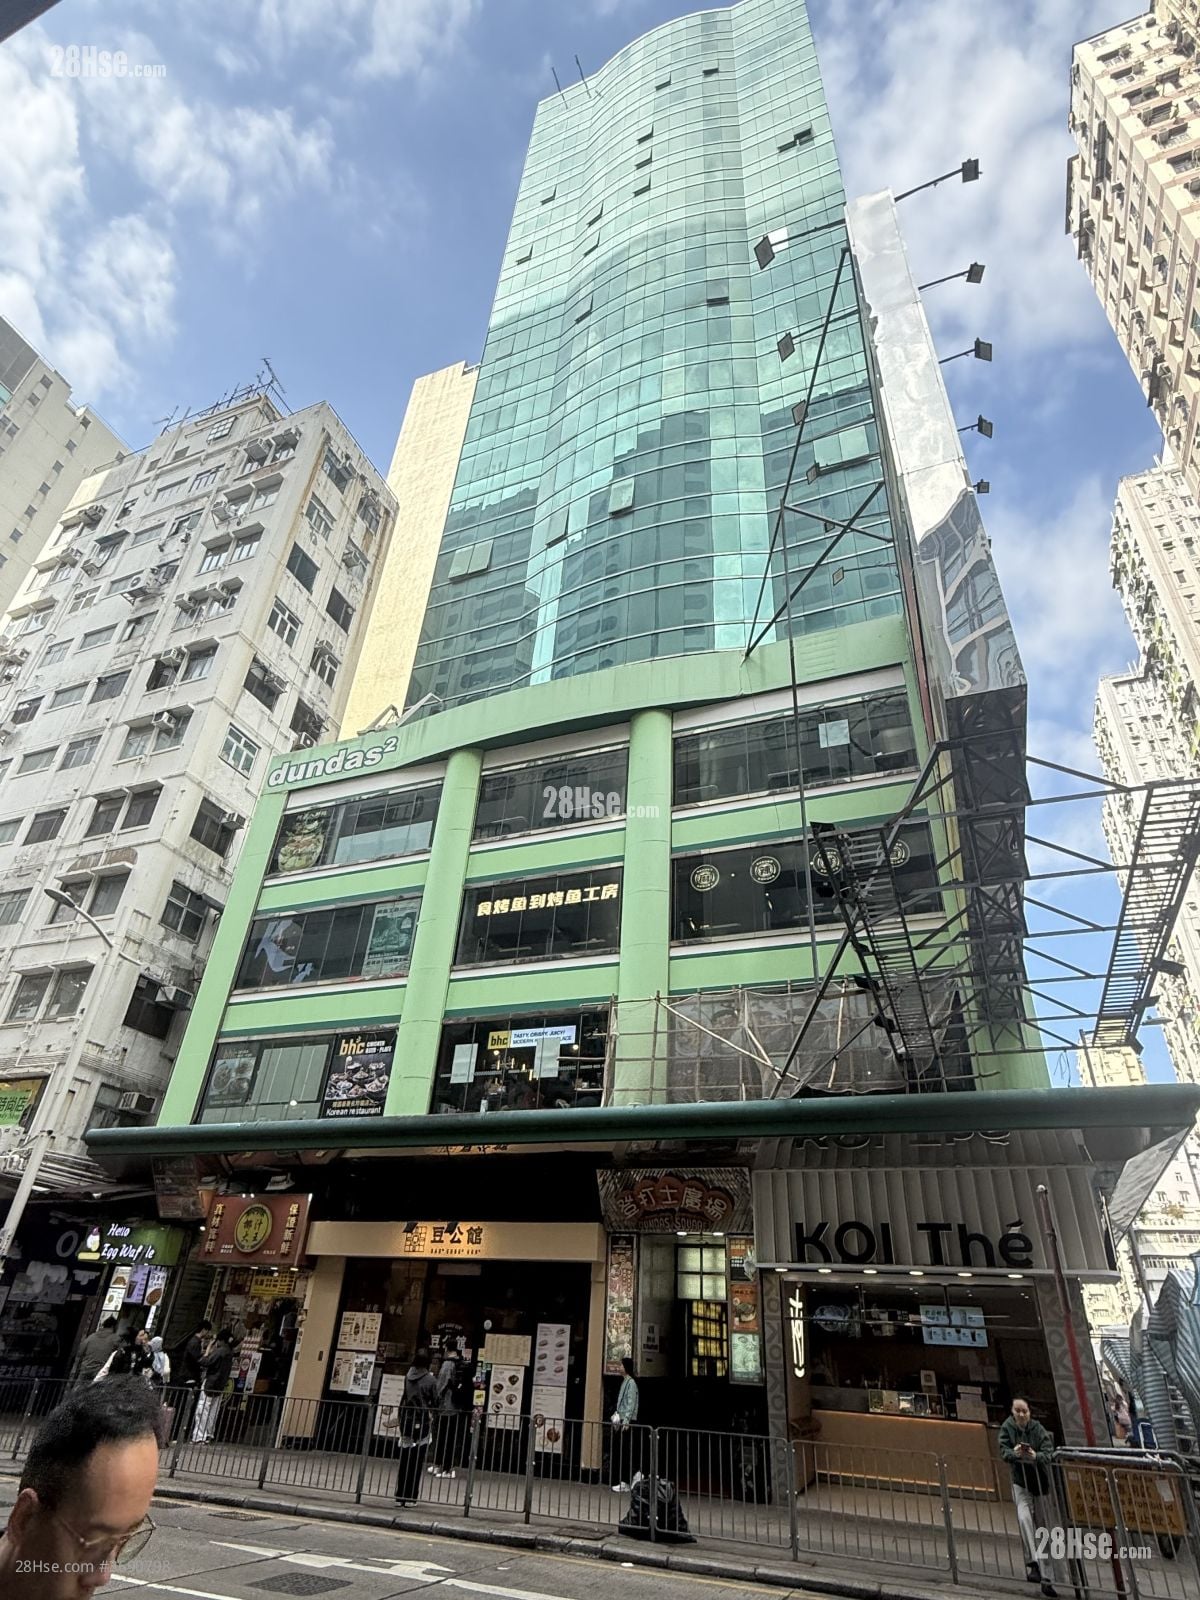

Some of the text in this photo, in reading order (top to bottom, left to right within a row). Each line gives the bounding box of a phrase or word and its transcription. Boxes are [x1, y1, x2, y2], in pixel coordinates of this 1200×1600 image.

[340, 1037, 365, 1056] bhc
[490, 1035, 508, 1046] bhc
[326, 1106, 382, 1116] Korean restaurant
[101, 1243, 118, 1260] Egg
[794, 1221, 896, 1265] KOI
[917, 1217, 1033, 1269] Thé
